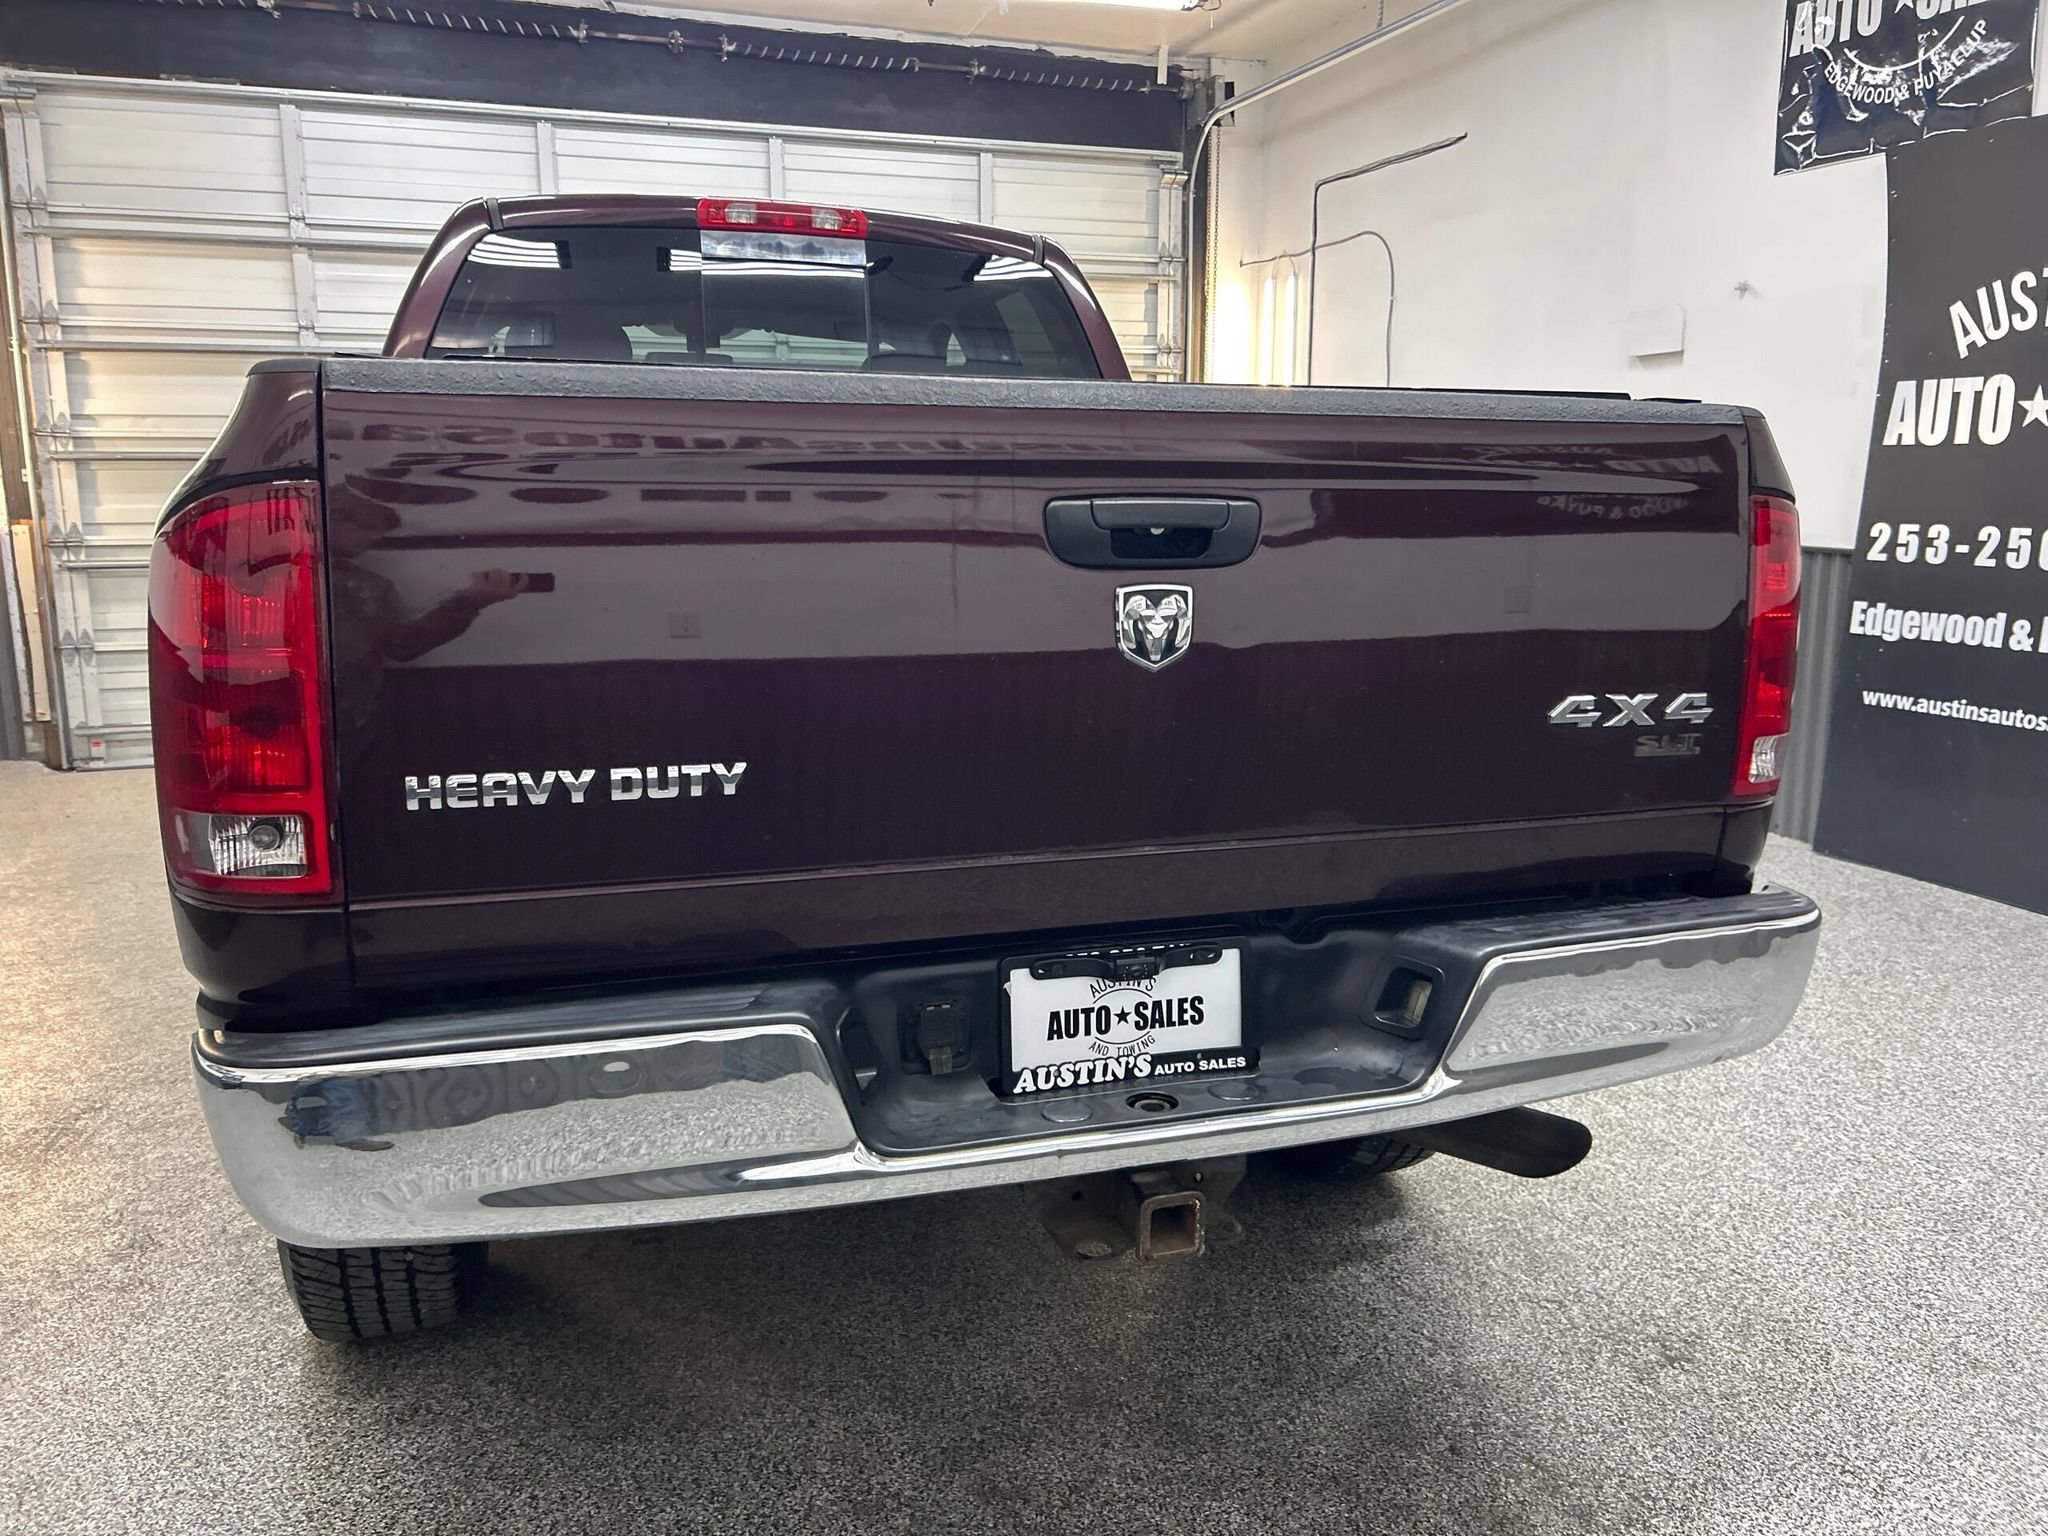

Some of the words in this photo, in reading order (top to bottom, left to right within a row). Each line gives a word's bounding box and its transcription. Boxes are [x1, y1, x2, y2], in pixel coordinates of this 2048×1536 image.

[1789, 0, 1883, 58] AUTO
[1824, 61, 1896, 104] EDGEWOOD
[1949, 267, 2048, 359] AUS
[1882, 373, 2016, 446] AUTO
[1849, 600, 2007, 649] Edgewood
[2008, 620, 2034, 651] &
[1862, 690, 2048, 732] www.austinsautos
[1634, 733, 1702, 757] SLT
[404, 769, 596, 810] HEAVY
[609, 762, 748, 801] DUTY
[1047, 1005, 1111, 1041] AUTO
[1134, 995, 1204, 1031] SALES
[1088, 1041, 1109, 1056] AND
[1117, 1034, 1156, 1057] TOWING
[1013, 1053, 1152, 1094] AUSTIN'S
[1154, 1062, 1195, 1076] AUTO
[1199, 1057, 1246, 1071] SALES
